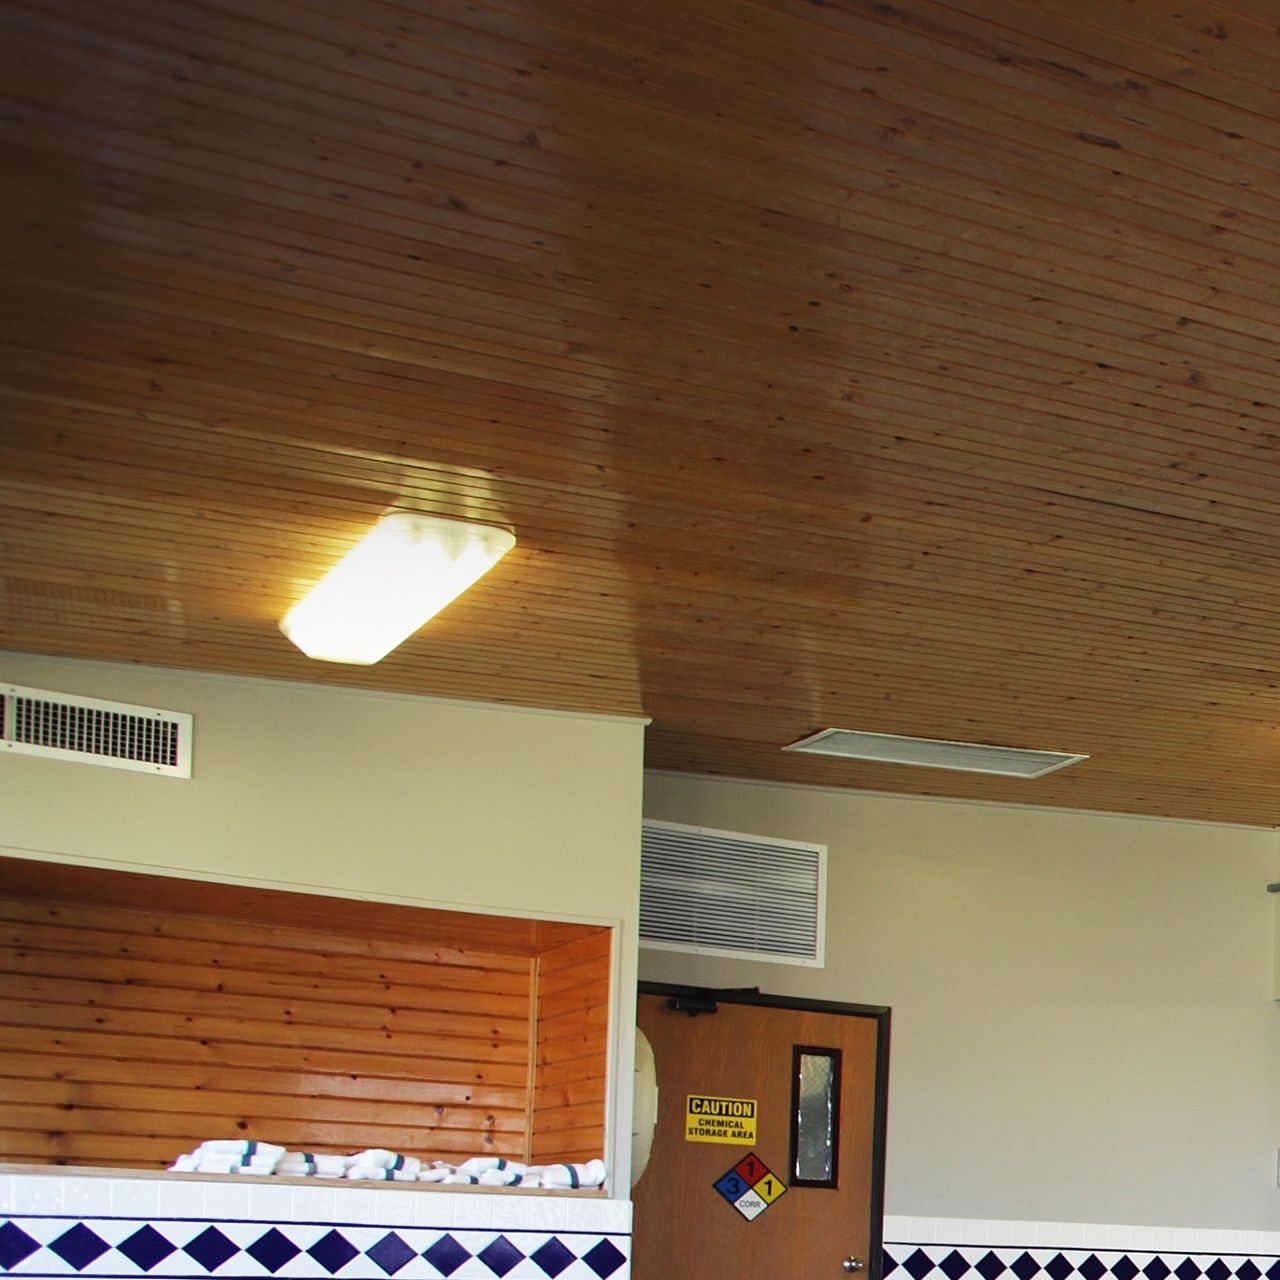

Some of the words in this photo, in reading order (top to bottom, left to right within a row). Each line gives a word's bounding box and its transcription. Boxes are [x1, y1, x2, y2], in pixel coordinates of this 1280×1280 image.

[692, 1099, 752, 1116] CAUTION
[698, 1118, 744, 1129] CHEMICAL
[688, 1128, 728, 1138] STORAGE
[731, 1130, 754, 1139] AREA
[746, 1161, 755, 1177] 1
[726, 1177, 740, 1194] 3
[764, 1180, 772, 1196] 1
